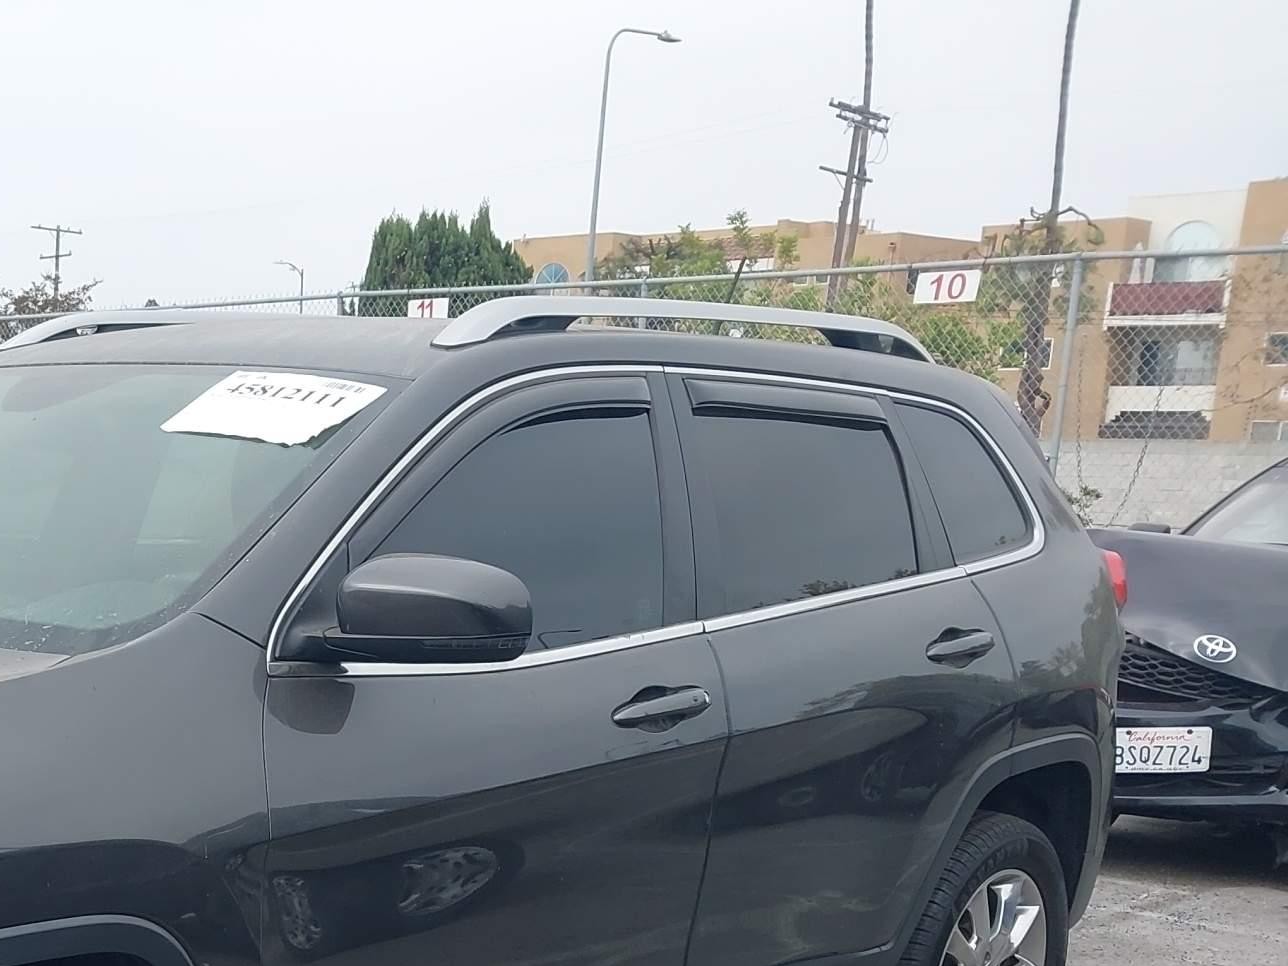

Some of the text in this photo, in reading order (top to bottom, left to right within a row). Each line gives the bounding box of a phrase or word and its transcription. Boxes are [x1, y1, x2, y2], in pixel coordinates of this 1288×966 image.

[930, 273, 967, 301] 10
[417, 300, 433, 318] 11
[227, 383, 346, 407] 45812111
[1128, 731, 1192, 745] California
